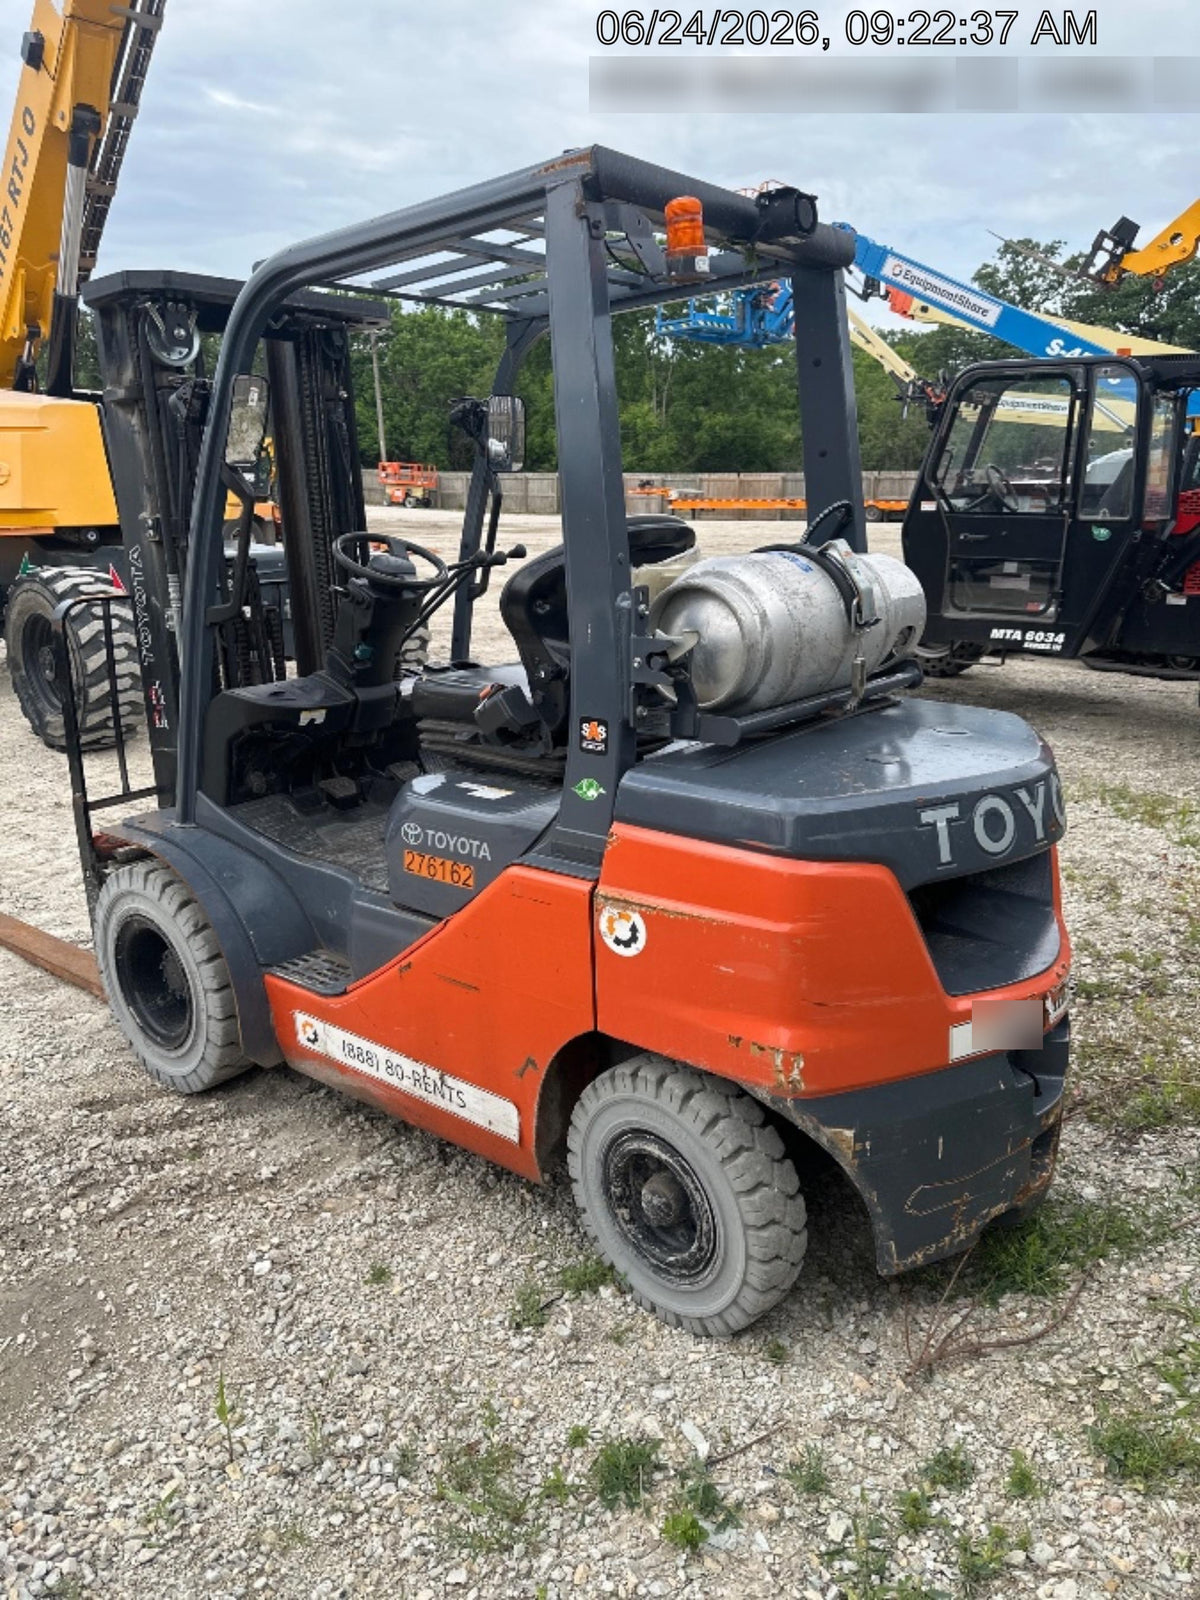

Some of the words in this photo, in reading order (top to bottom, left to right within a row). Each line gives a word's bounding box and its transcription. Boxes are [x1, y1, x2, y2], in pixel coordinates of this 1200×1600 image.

[8, 139, 28, 208] RTJ
[902, 269, 990, 318] EquipmentShare
[129, 545, 155, 666] TOYOTA
[990, 628, 1022, 641] MTA
[1025, 630, 1066, 644] 6034
[405, 850, 473, 888] 276162
[425, 829, 491, 861] TOYOTA
[342, 1039, 379, 1072] (888)
[384, 1058, 467, 1109] 80-RENTS
